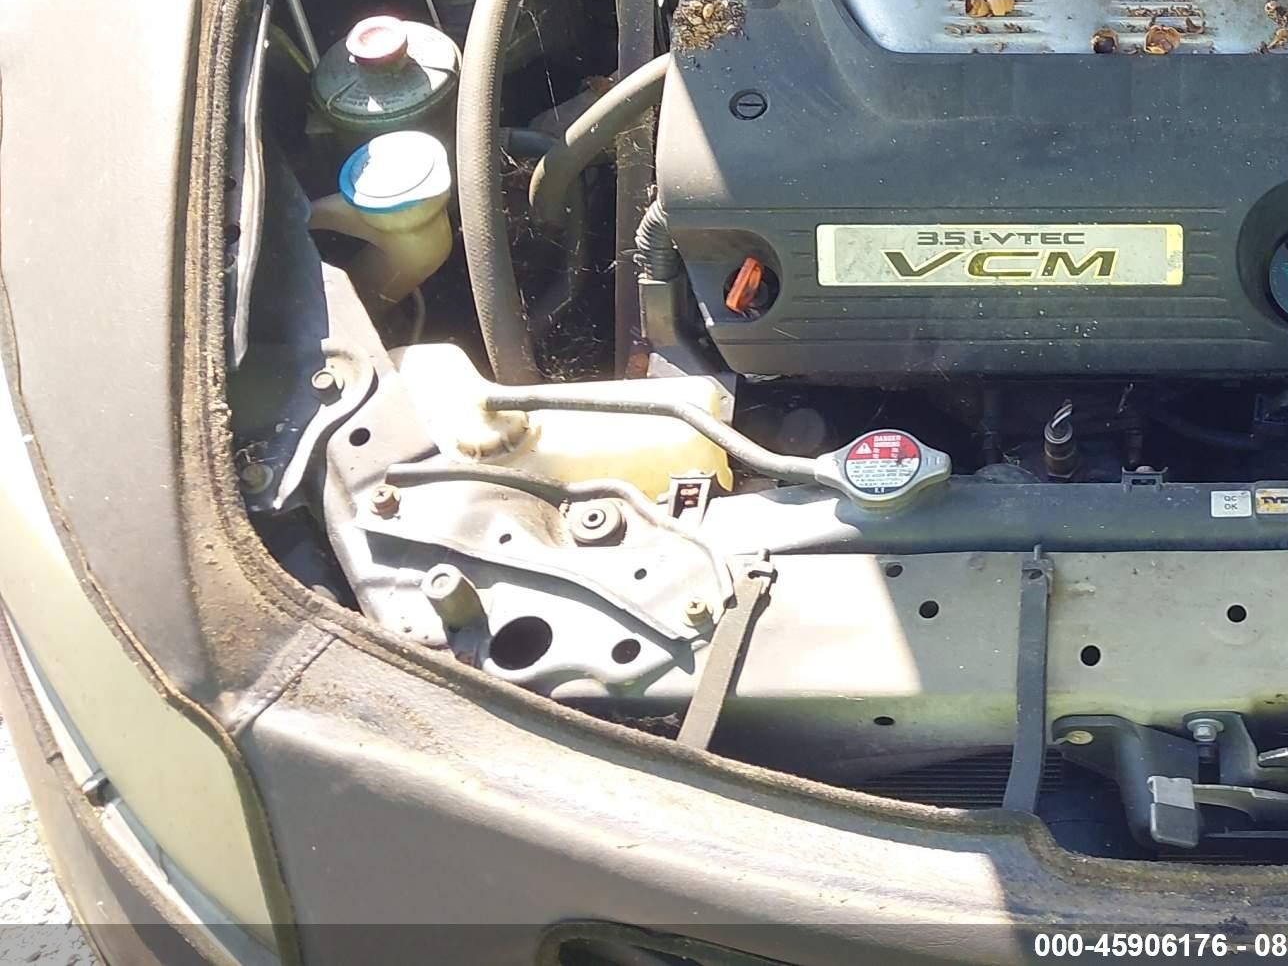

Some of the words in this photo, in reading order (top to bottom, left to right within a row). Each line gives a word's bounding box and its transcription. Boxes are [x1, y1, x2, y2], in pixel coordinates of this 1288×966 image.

[917, 231, 966, 246] 3.5
[974, 230, 1085, 246] i-VTEC
[881, 249, 1119, 280] VCM
